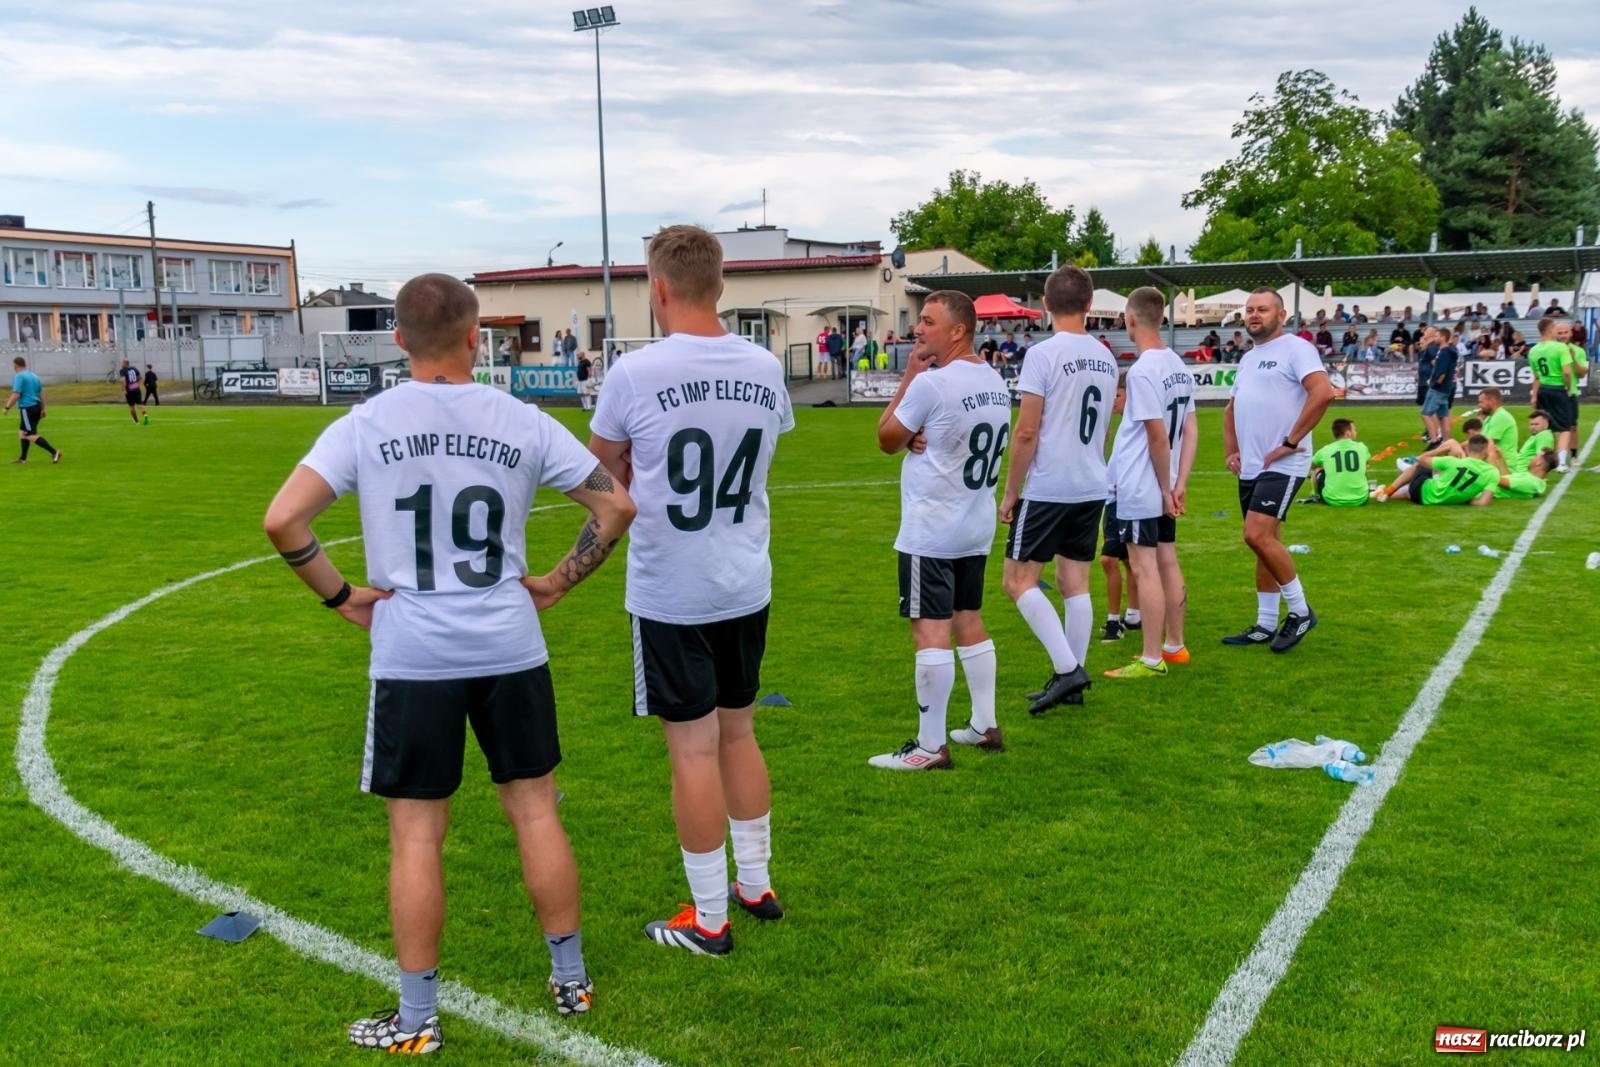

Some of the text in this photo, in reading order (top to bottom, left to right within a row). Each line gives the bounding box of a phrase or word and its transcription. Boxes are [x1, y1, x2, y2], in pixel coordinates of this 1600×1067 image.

[1063, 362, 1076, 377] FC
[1075, 359, 1088, 371] IMP
[1258, 360, 1278, 370] IMP
[1537, 357, 1550, 377] 6
[656, 379, 777, 412] FC IMP ELECTRO
[962, 396, 976, 412] FC
[975, 392, 990, 407] IMP
[1079, 385, 1102, 445] 6
[1167, 396, 1191, 450] 17
[379, 433, 521, 469] FC IMP ELECTRO
[1331, 450, 1360, 473] 10
[666, 427, 763, 532] 94
[1450, 466, 1479, 492] 17
[395, 484, 506, 591] 19
